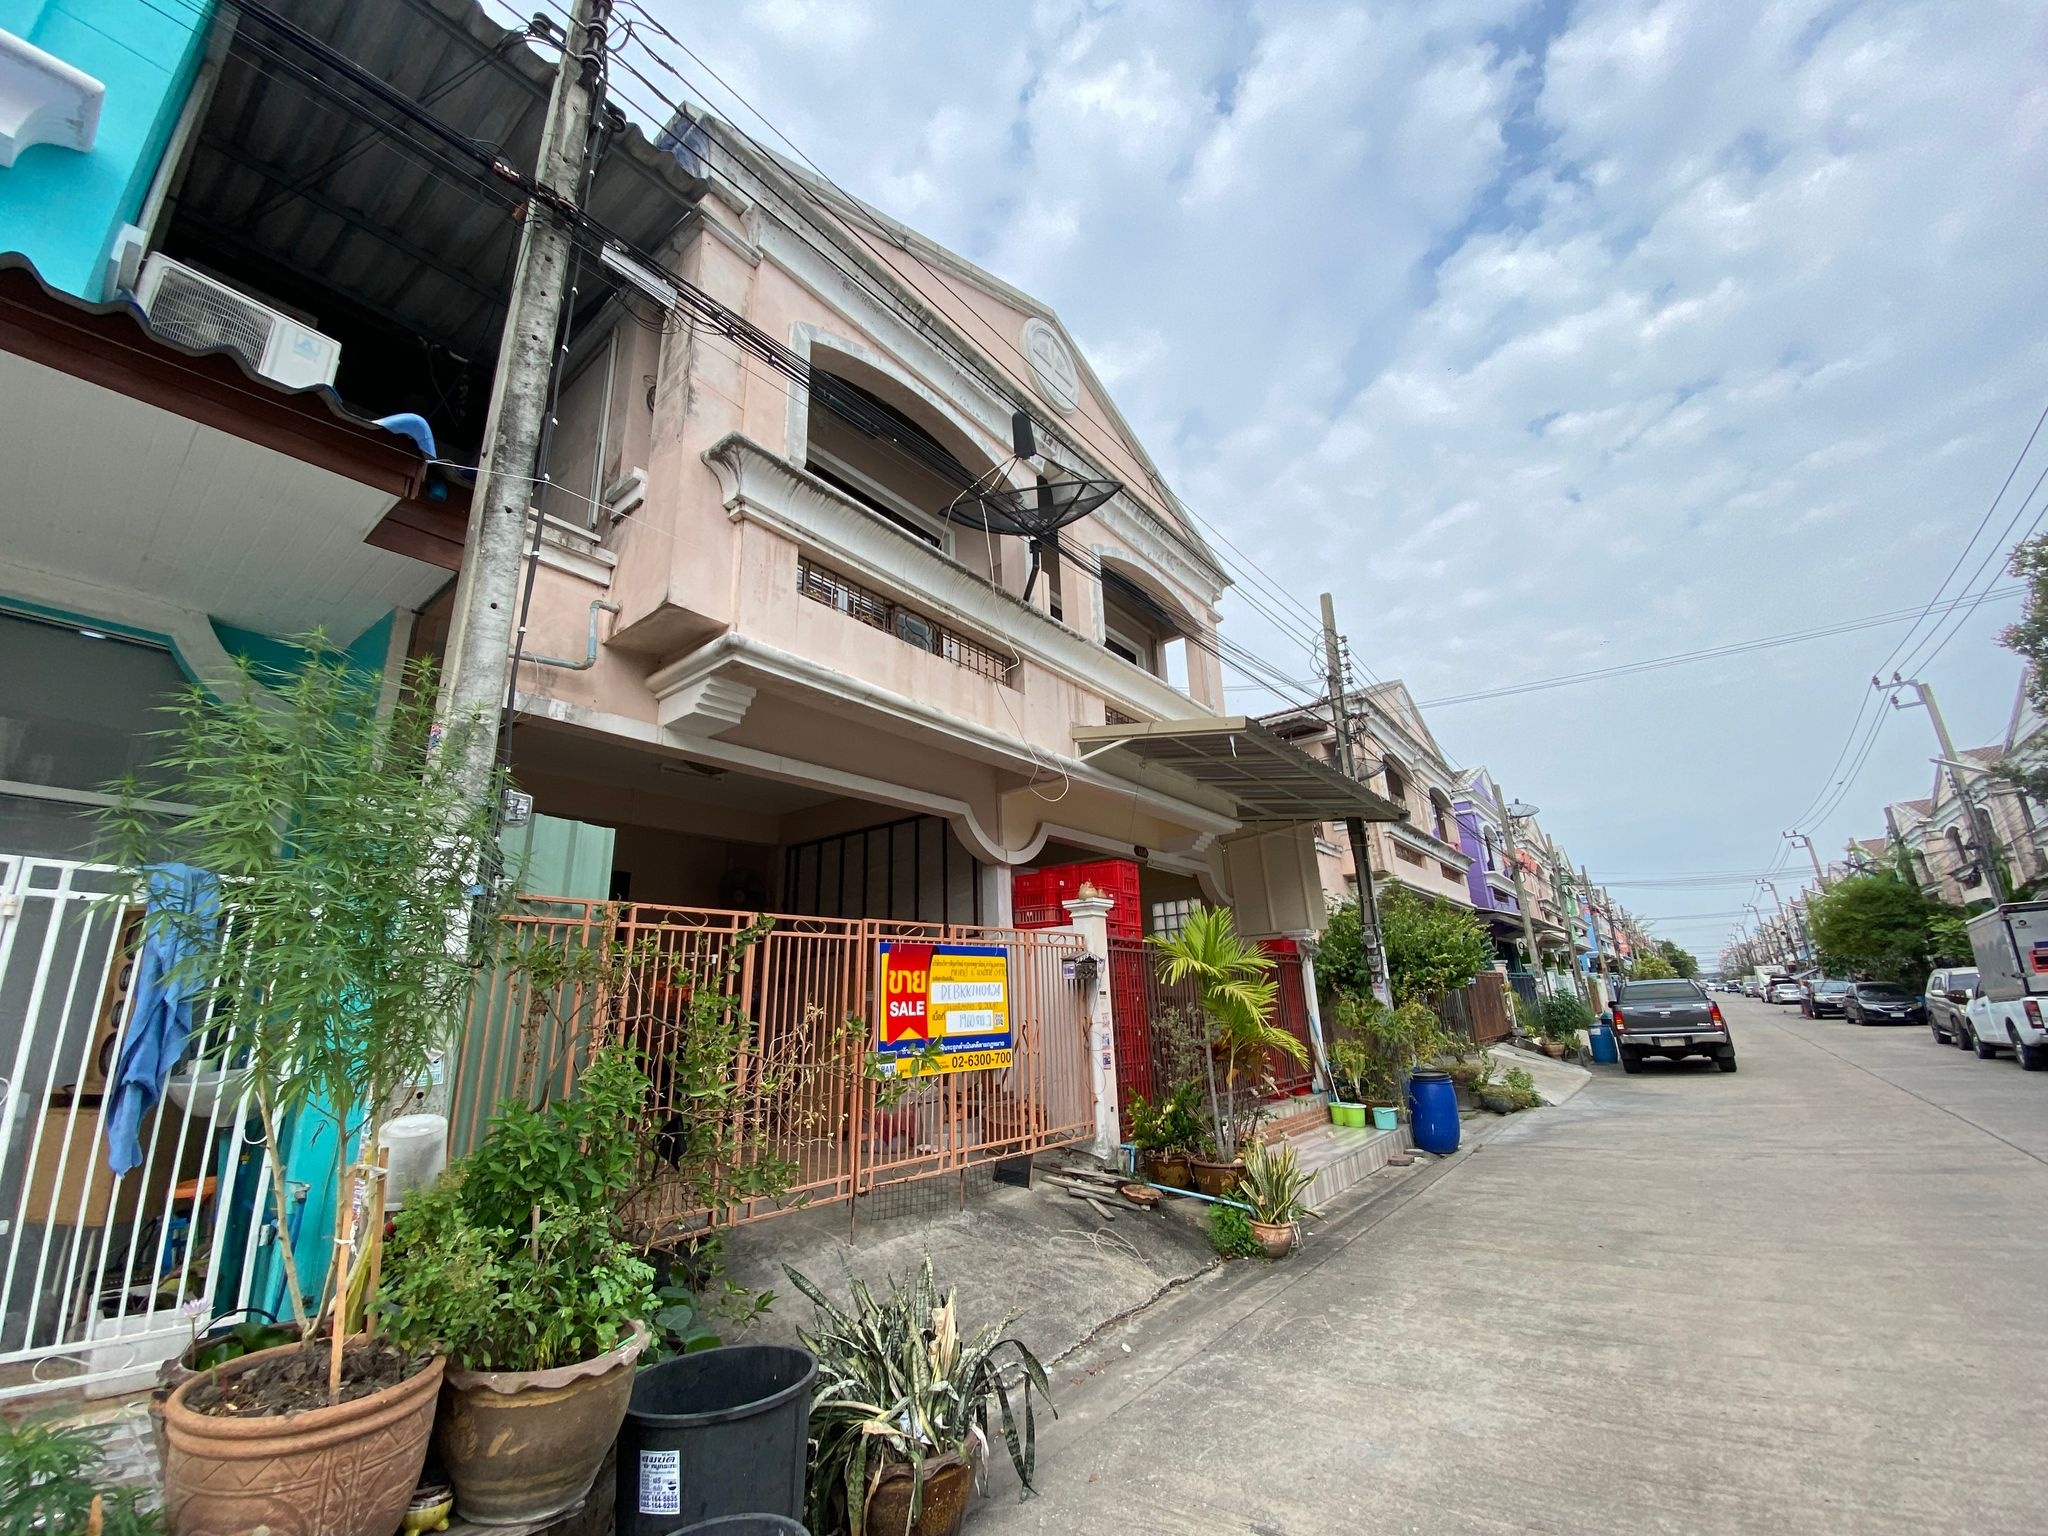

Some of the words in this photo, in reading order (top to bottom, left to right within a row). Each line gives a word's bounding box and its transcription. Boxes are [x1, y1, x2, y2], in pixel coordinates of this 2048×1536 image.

[889, 969, 926, 994] ขาย
[889, 1000, 925, 1017] SALE
[952, 1052, 1011, 1068] 02-6300-700
